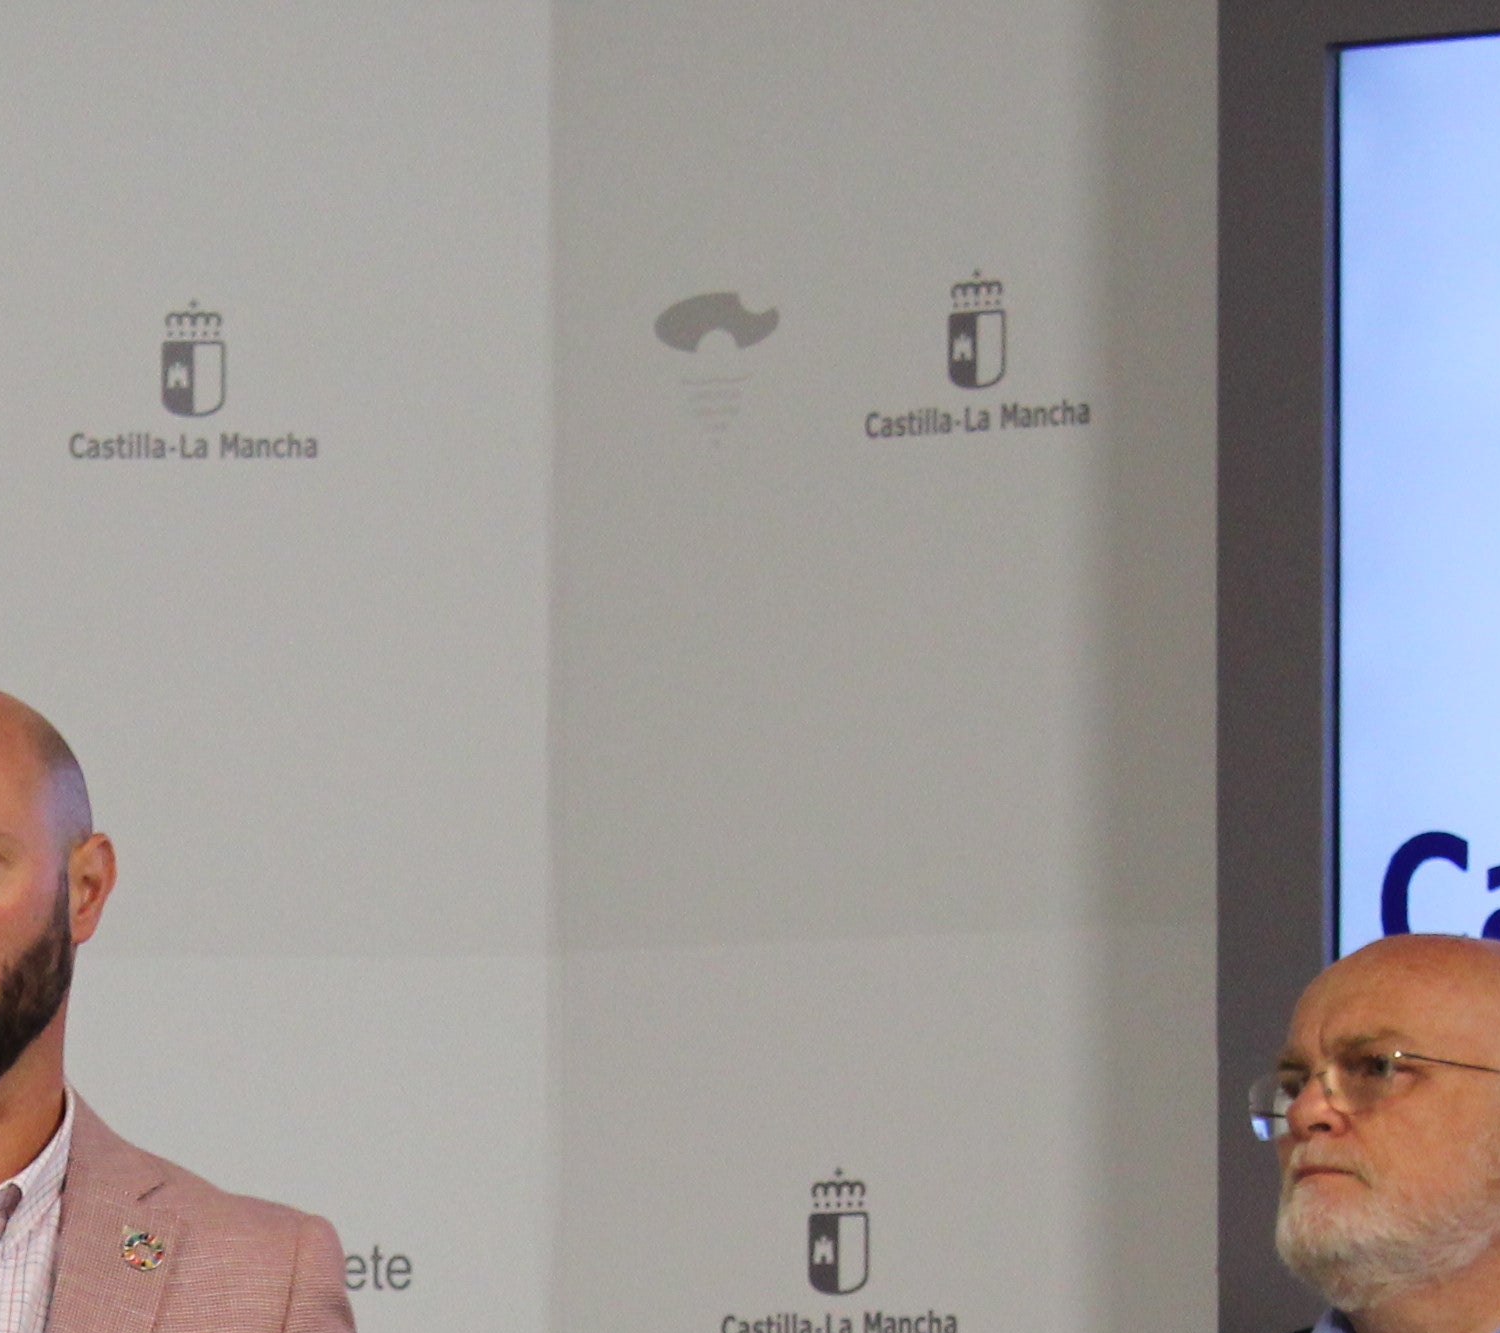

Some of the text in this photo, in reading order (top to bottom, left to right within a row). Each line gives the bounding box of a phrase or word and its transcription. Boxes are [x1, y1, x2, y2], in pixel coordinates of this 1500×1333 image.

[1000, 399, 1094, 429] Mancha
[68, 431, 319, 460] Castilla-La Mancha
